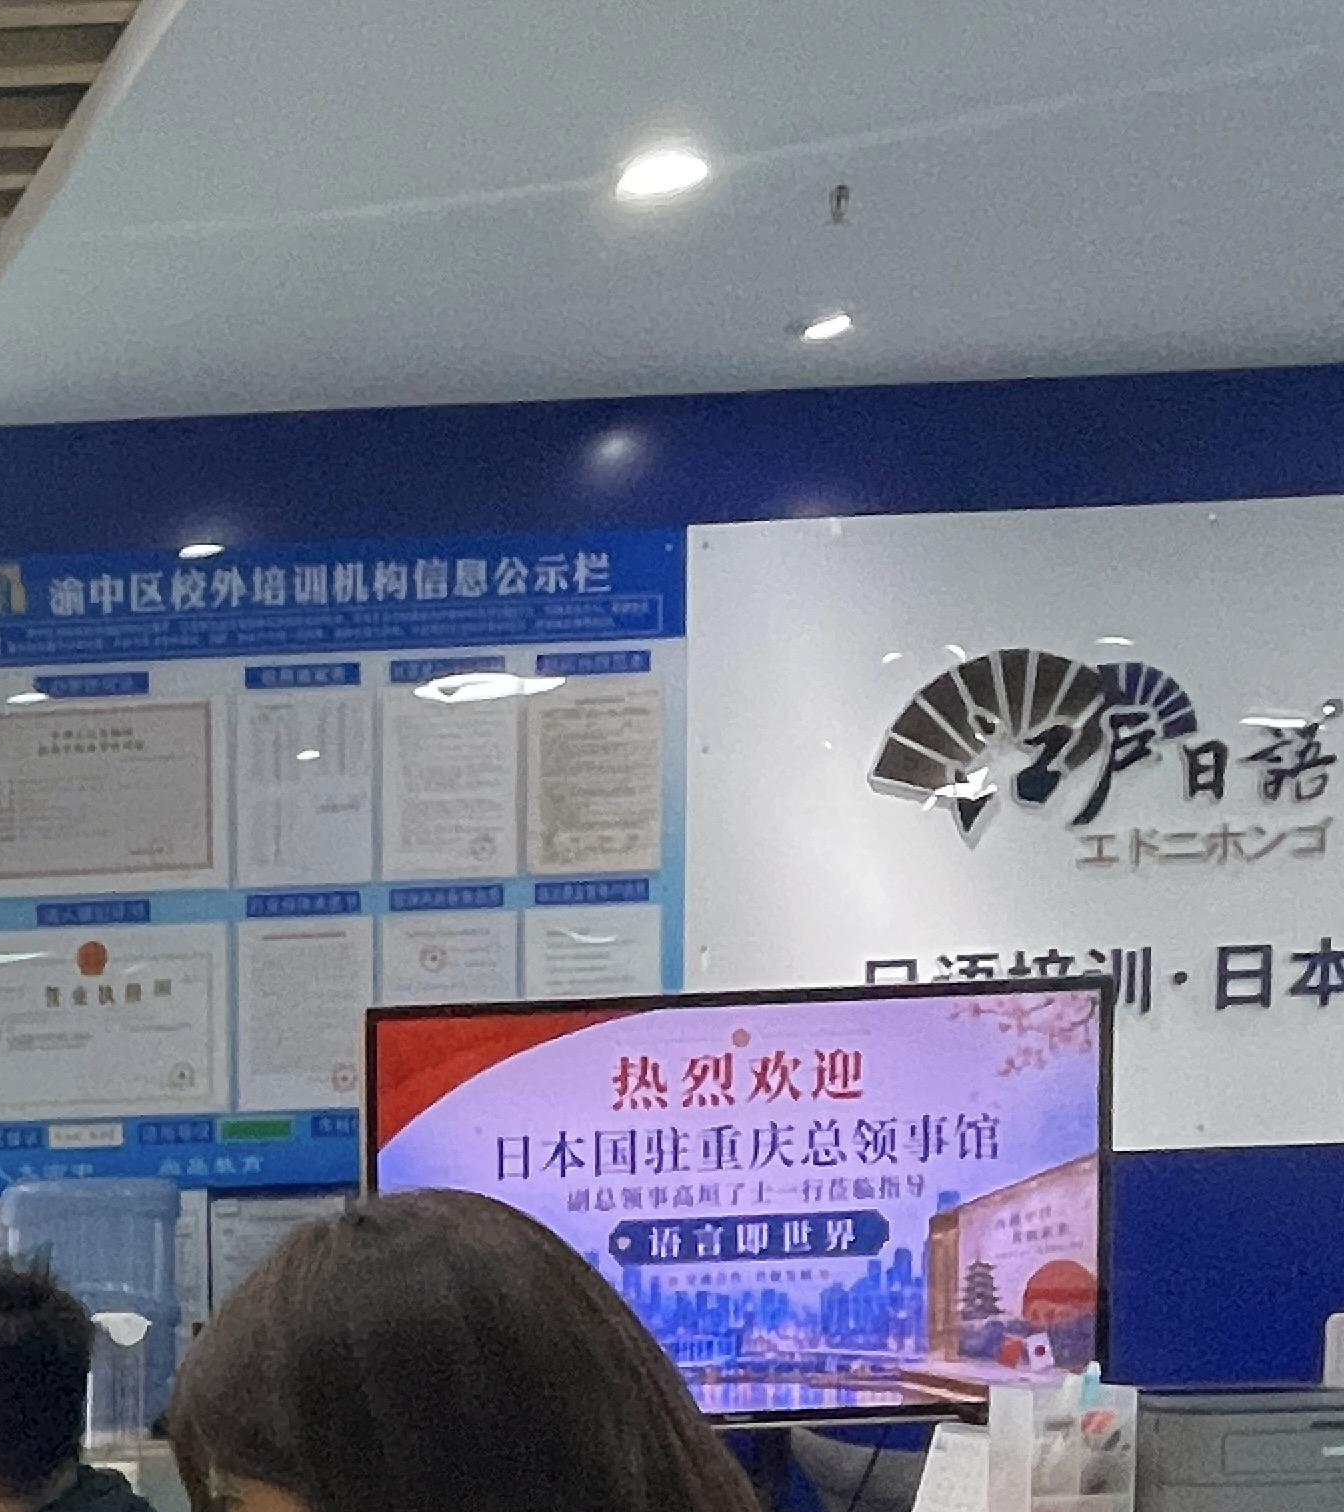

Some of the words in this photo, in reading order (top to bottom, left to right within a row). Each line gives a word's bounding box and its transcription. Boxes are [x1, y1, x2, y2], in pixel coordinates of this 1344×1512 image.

[49, 551, 612, 617] 渝中区校外培训机构信息公示栏
[1075, 815, 1335, 870] エドニホンゴ
[612, 1048, 864, 1112] 热烈欢迎
[495, 1112, 1001, 1182] 日本国驻重庆总领事馆
[648, 1218, 857, 1259] 语言即世界
